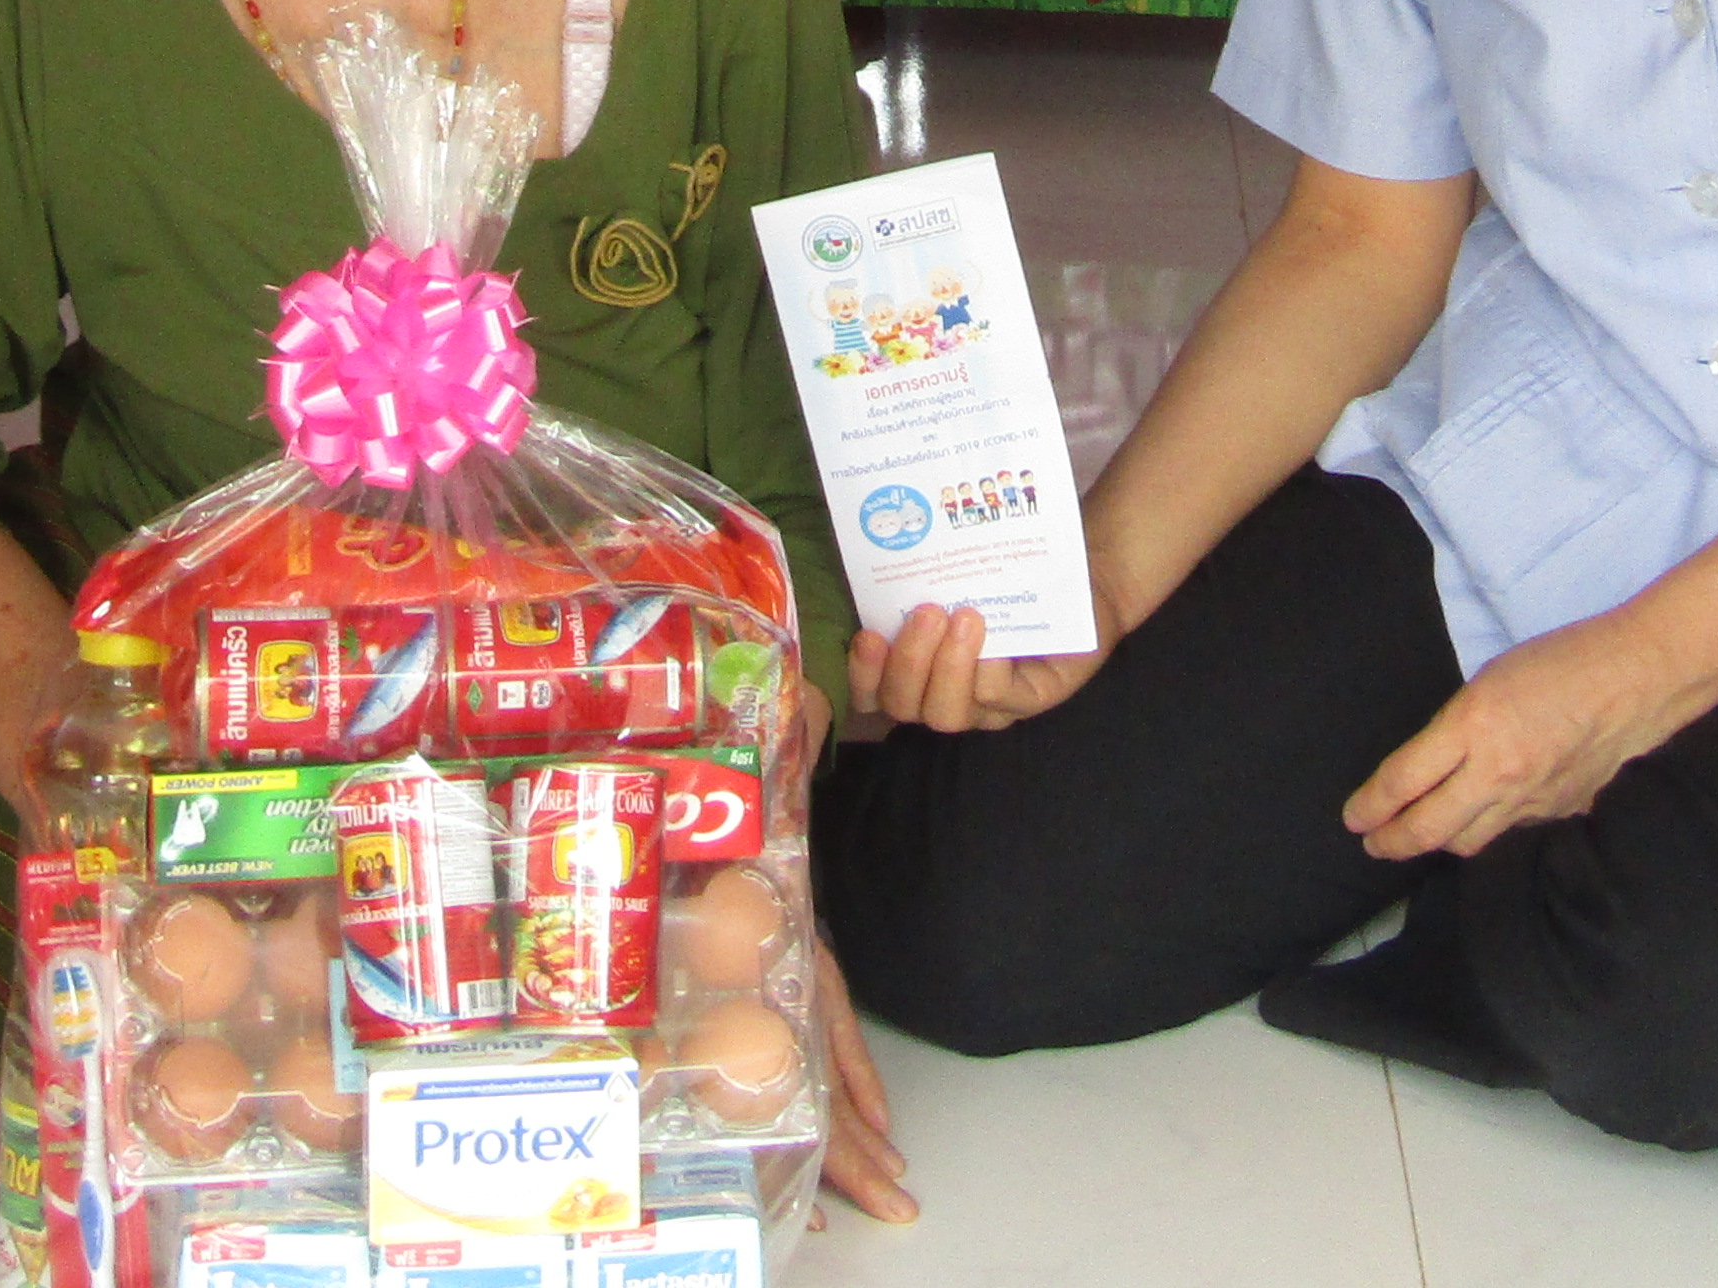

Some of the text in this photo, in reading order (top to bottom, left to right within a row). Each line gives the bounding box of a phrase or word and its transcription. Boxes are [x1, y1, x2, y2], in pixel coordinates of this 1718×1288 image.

[864, 362, 969, 401] เอกสารความรู้
[414, 1115, 598, 1168] Protex
